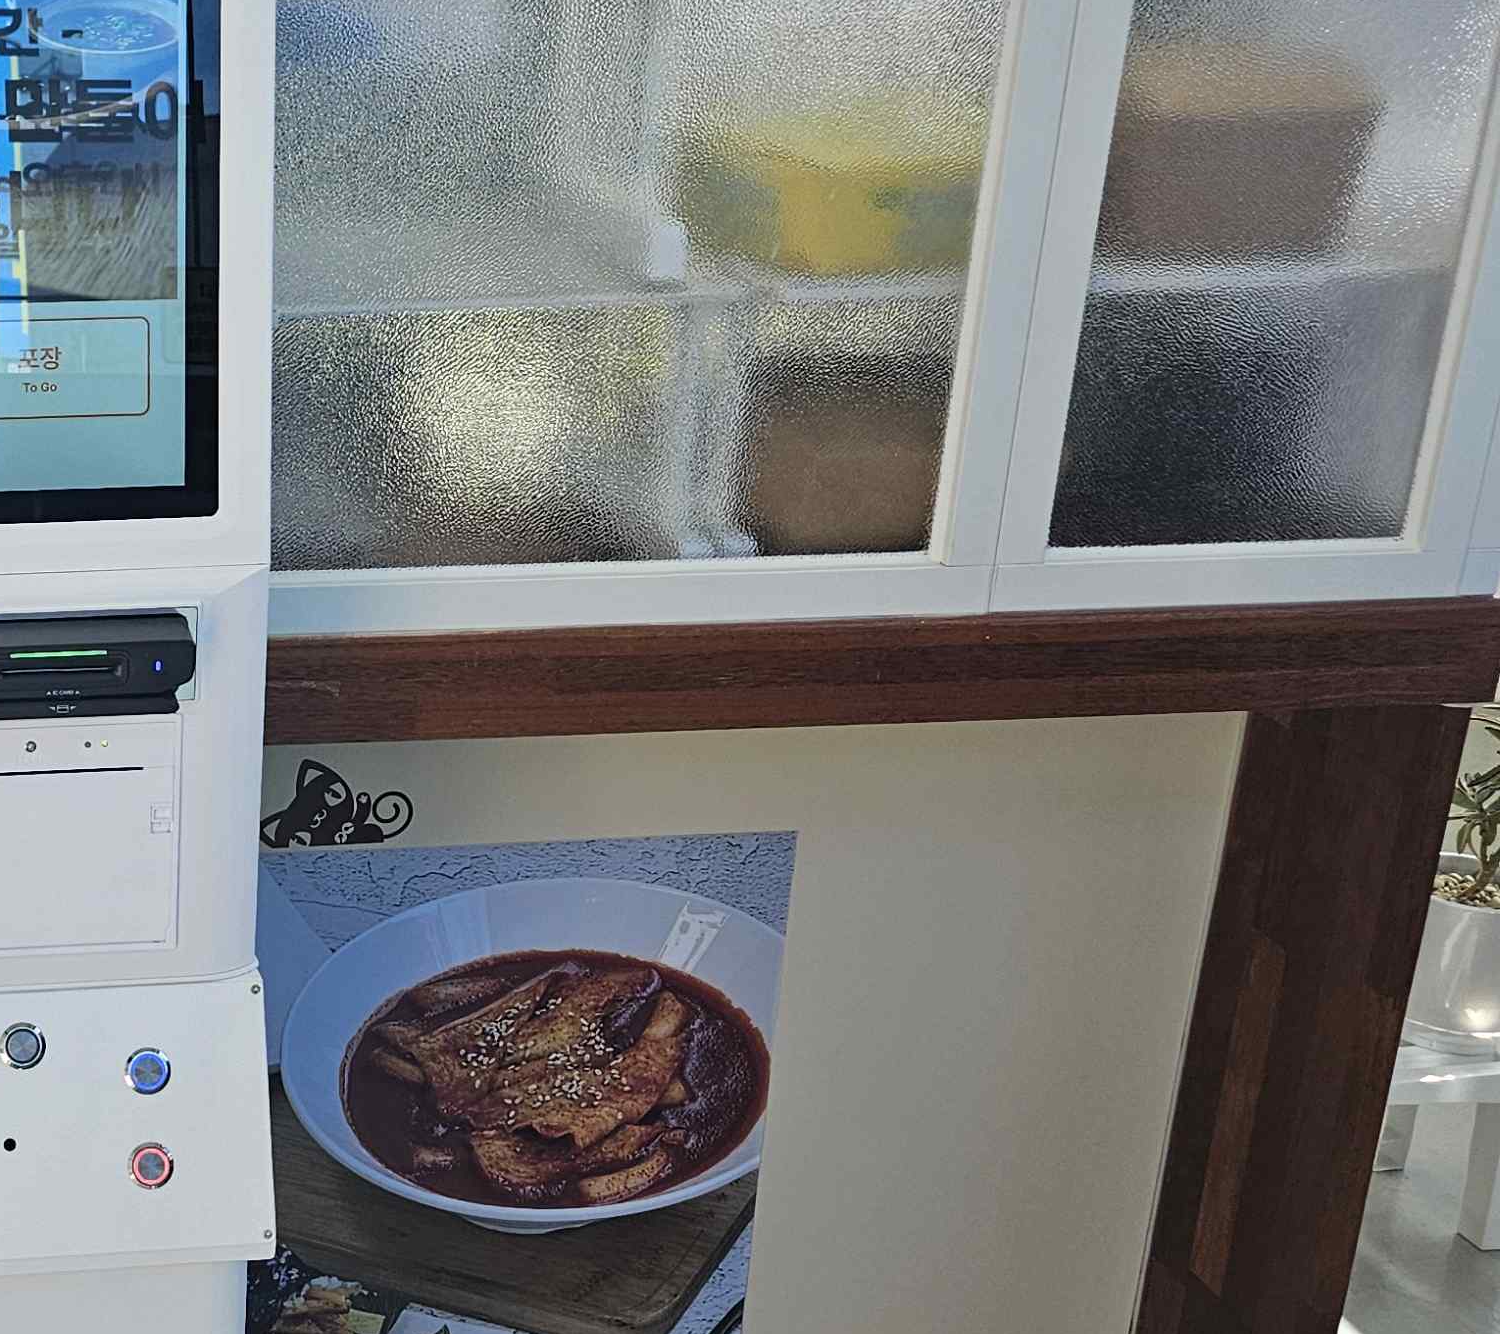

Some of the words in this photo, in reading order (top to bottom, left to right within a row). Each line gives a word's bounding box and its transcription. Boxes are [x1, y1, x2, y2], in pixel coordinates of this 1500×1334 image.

[18, 346, 62, 371] 포장
[23, 381, 39, 394] To
[40, 381, 58, 394] Go
